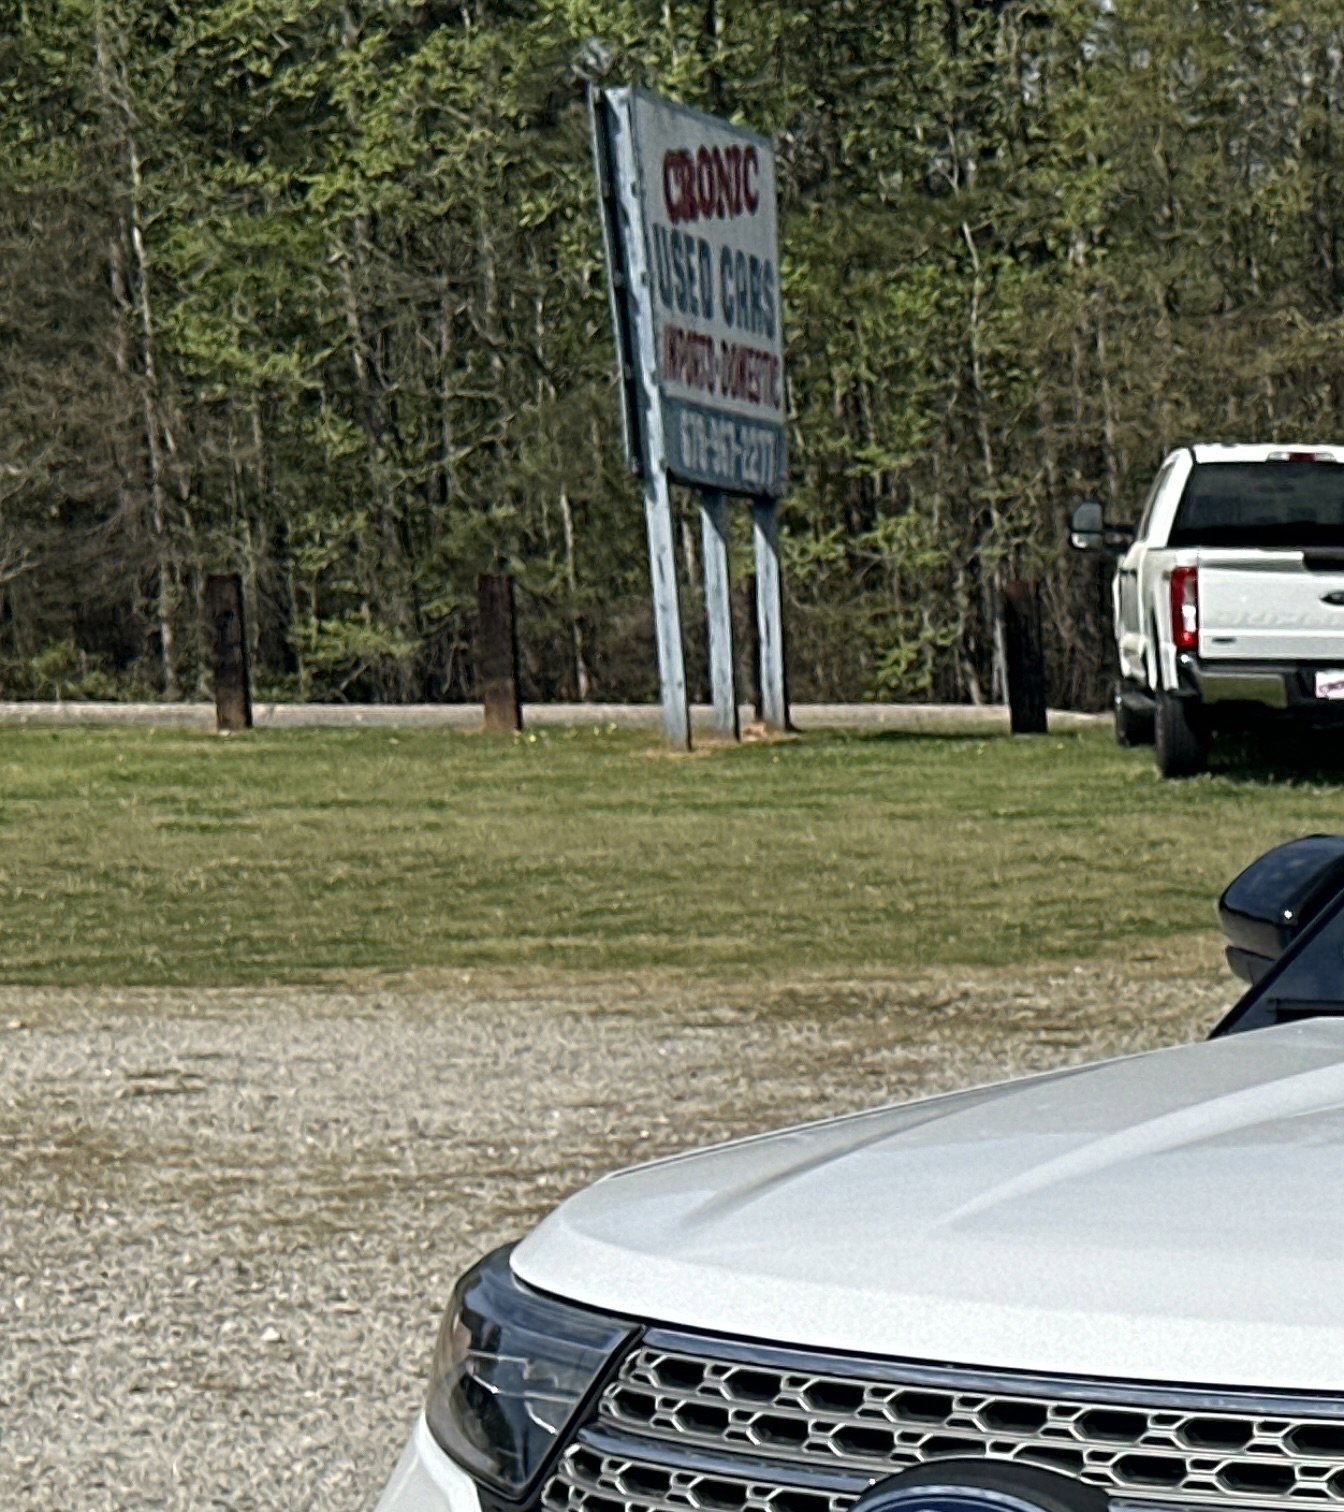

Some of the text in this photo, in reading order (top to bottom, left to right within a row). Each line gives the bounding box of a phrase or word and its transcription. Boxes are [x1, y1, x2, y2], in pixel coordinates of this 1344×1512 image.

[662, 143, 759, 225] CRONIC
[653, 222, 776, 341] USED CARS
